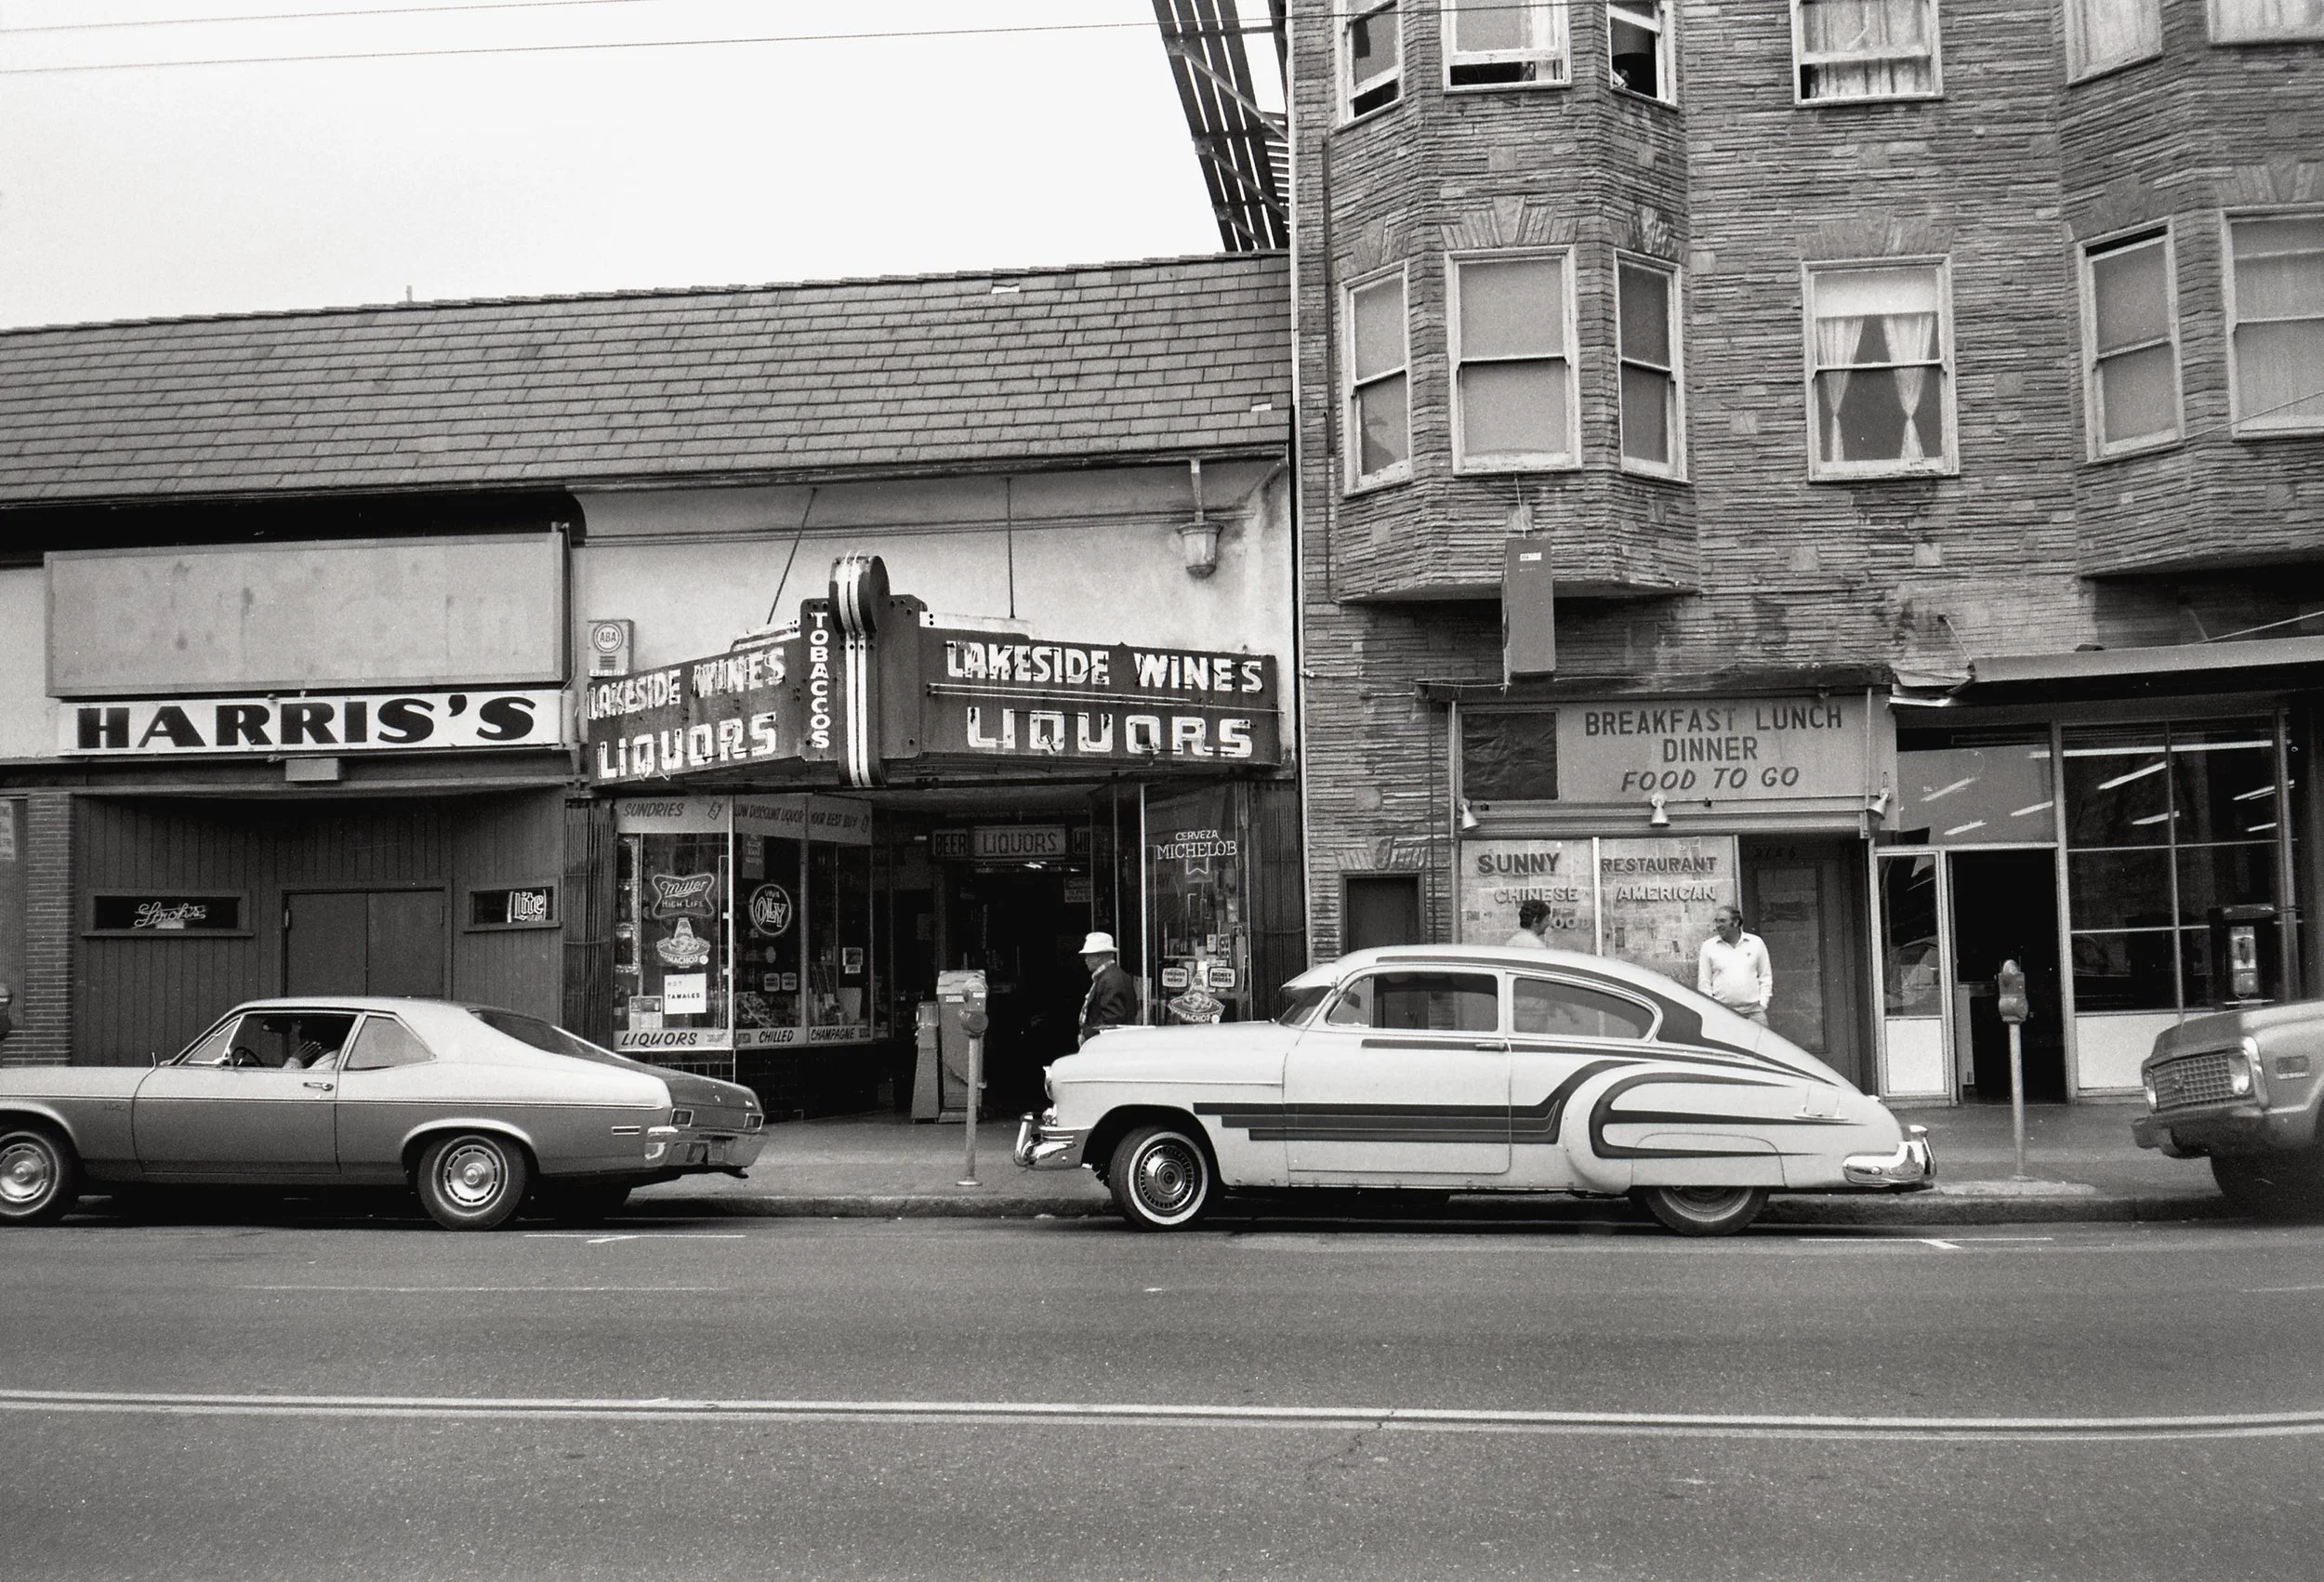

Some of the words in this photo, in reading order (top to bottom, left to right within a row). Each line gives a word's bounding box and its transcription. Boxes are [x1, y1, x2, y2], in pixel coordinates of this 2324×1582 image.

[600, 631, 616, 642] ABA
[946, 640, 1110, 685] LAKESIDE
[1133, 653, 1264, 692] WINES
[588, 669, 681, 720] LAKESIDE
[693, 647, 785, 698] WINES
[809, 612, 831, 749] TOBACCOS
[77, 693, 536, 749] HARRIS'S
[967, 706, 1253, 758] LIQUORS
[1584, 707, 1736, 736] BREAKFAST
[1755, 705, 1842, 732] LUNCH
[598, 711, 777, 781] LIQUORS
[1662, 736, 1759, 762] DINNER
[1620, 769, 1697, 791] FOOD
[1712, 767, 1748, 789] TO
[1761, 766, 1800, 787] GO
[623, 802, 685, 817] SUNDRIES
[935, 834, 967, 855] BEER
[983, 833, 1058, 853] LIQUORS
[1175, 830, 1219, 841] CERVEZA
[1156, 840, 1237, 860] MICHELOB
[1477, 852, 1561, 875] SUNNY
[1600, 857, 1717, 874] RESTAURANT
[660, 880, 707, 897] Miller
[1494, 887, 1578, 904] CHINESE
[1617, 886, 1717, 903] AMERICAN
[514, 892, 544, 920] Lite
[662, 899, 681, 908] HIGH
[685, 899, 704, 908] LIFE
[755, 896, 787, 928] OLY
[667, 992, 700, 1000] TAMALES
[621, 1033, 698, 1046] LIQUORS
[759, 1030, 794, 1044] CHILLED
[811, 1027, 855, 1041] CHAMPAGNE
